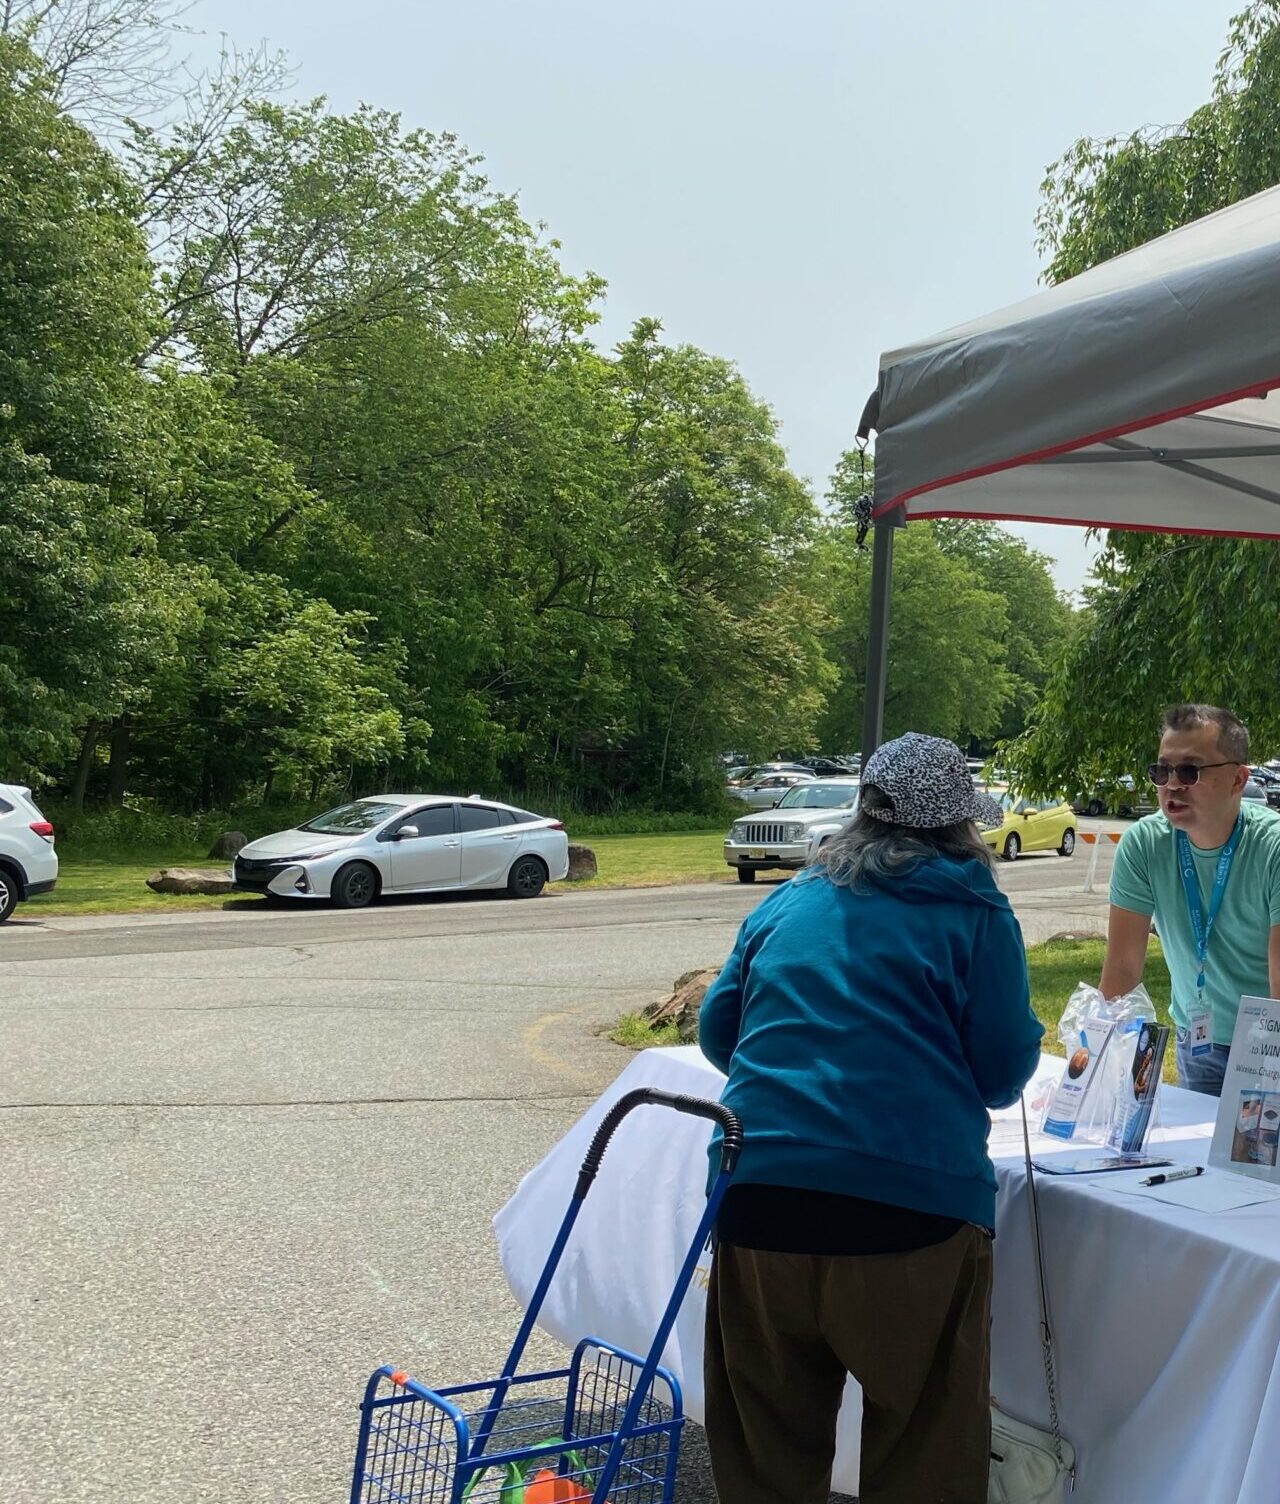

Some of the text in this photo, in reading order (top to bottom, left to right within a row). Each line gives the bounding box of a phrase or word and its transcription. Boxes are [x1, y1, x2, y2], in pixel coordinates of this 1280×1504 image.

[1259, 1018, 1280, 1033] SIGN
[1251, 1045, 1259, 1055] to
[1260, 1043, 1280, 1057] WIN
